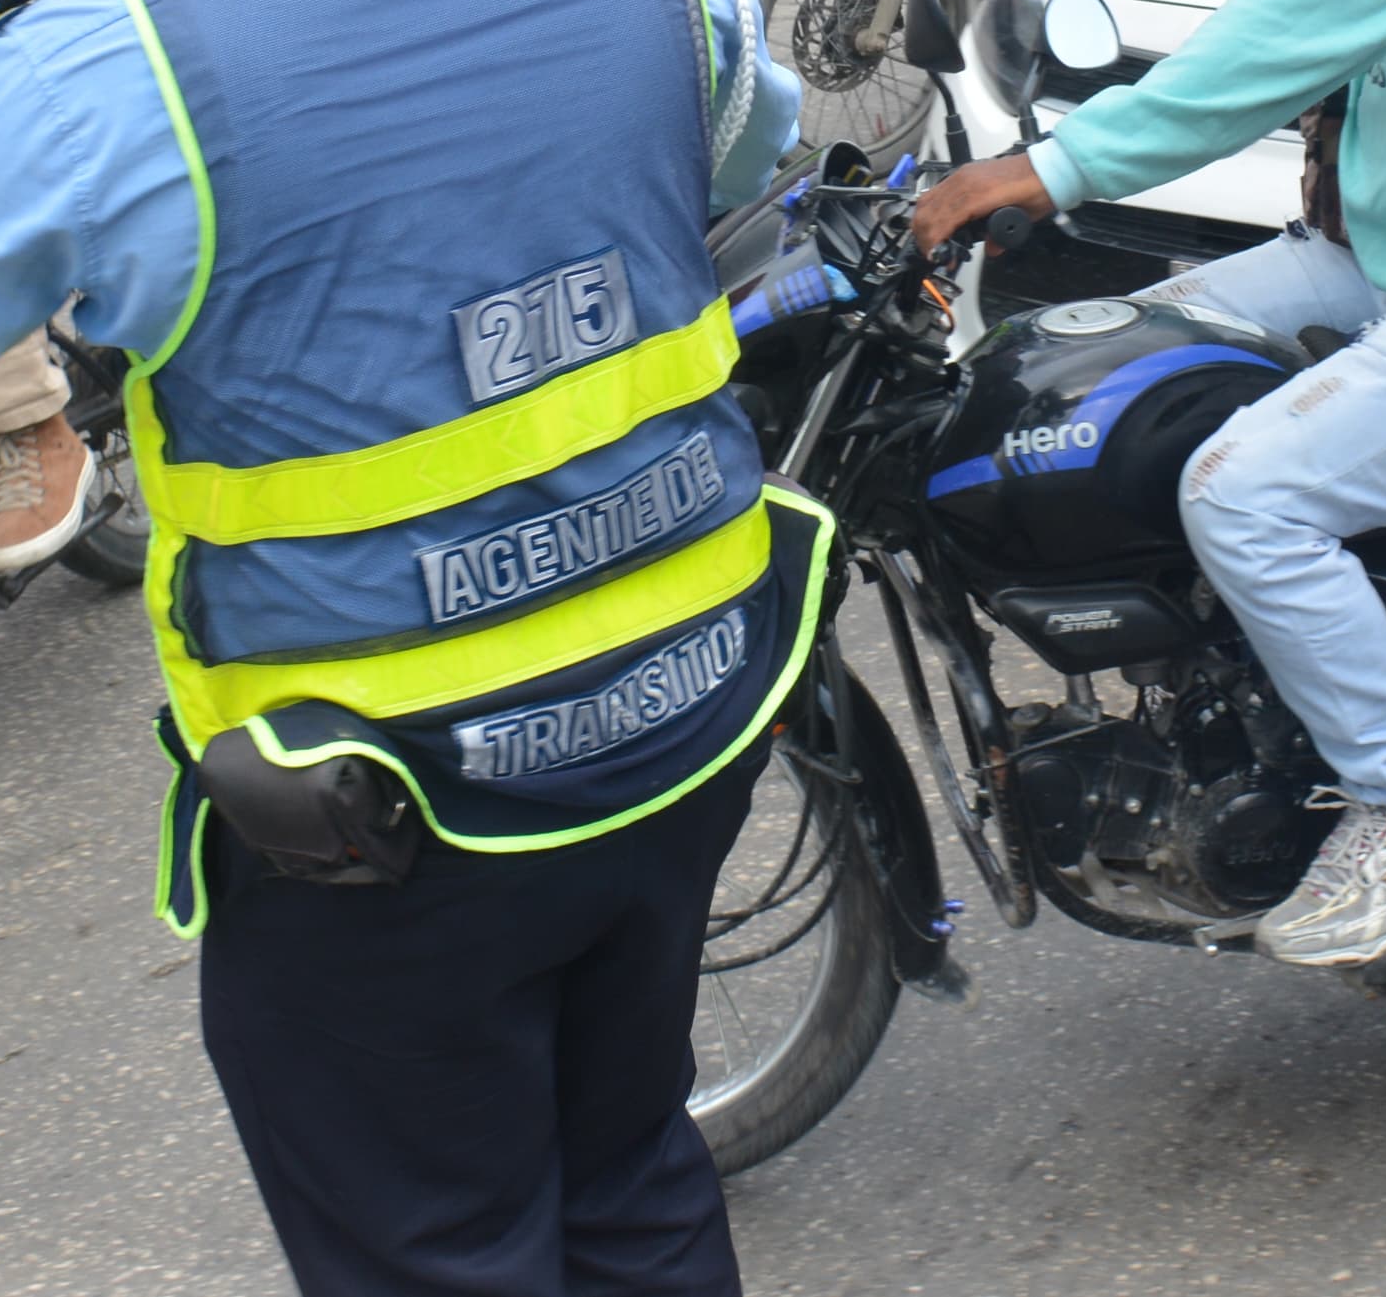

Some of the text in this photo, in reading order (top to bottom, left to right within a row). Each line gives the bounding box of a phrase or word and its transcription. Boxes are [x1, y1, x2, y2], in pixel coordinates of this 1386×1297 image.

[478, 264, 616, 388] 275
[443, 436, 725, 618] AGENTE DE
[1047, 609, 1112, 625] POWER
[1060, 618, 1123, 634] START
[483, 619, 743, 778] TRANSITO
